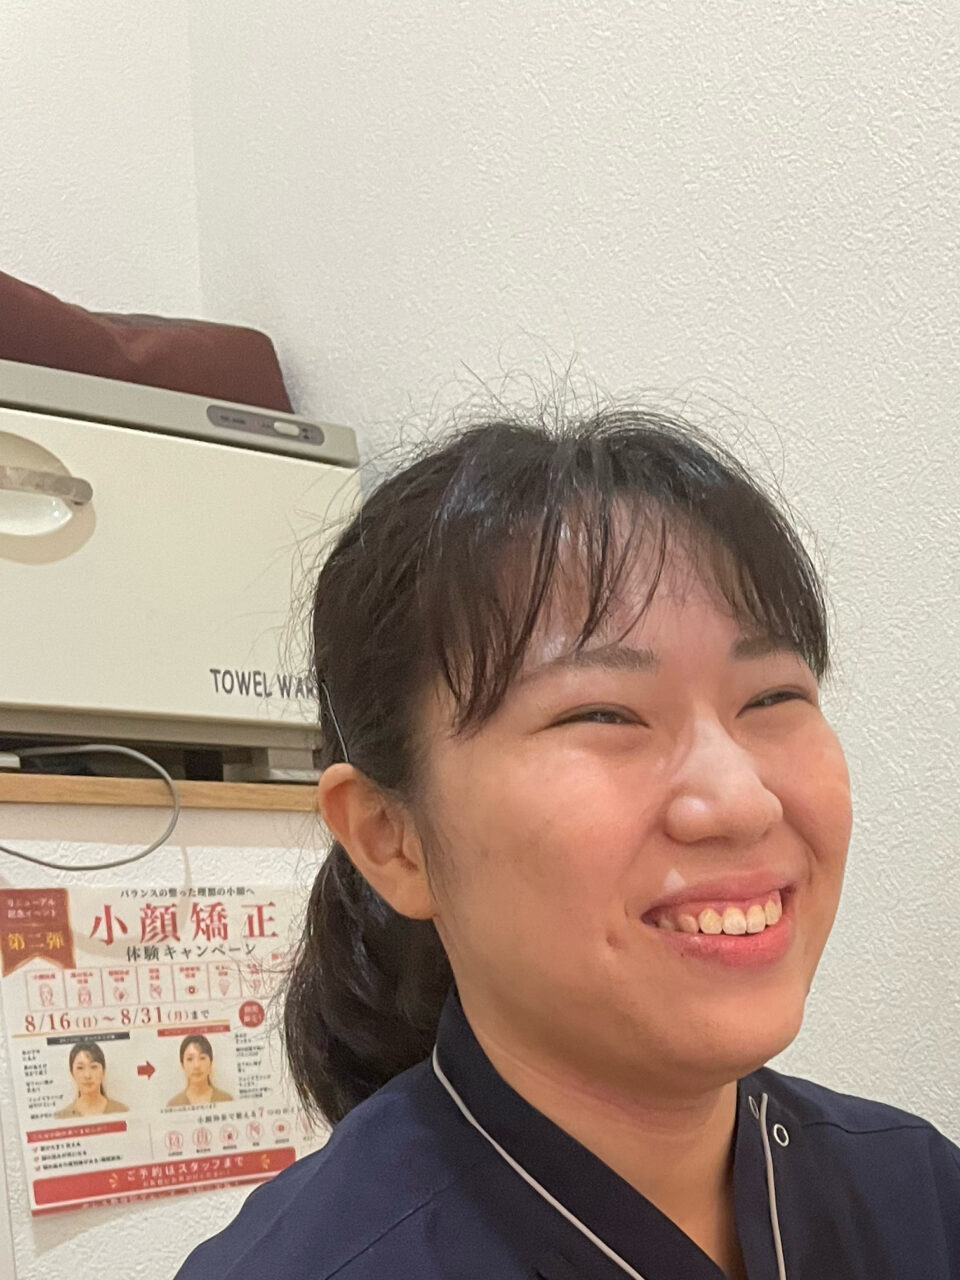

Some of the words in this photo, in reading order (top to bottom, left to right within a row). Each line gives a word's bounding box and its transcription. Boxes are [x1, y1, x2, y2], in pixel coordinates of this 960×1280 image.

[210, 669, 272, 698] TOWEL
[89, 901, 279, 946] 小顔矯正
[126, 943, 256, 962] 体験キャンペーン
[127, 1156, 244, 1182] ご予約はスタッフまで
